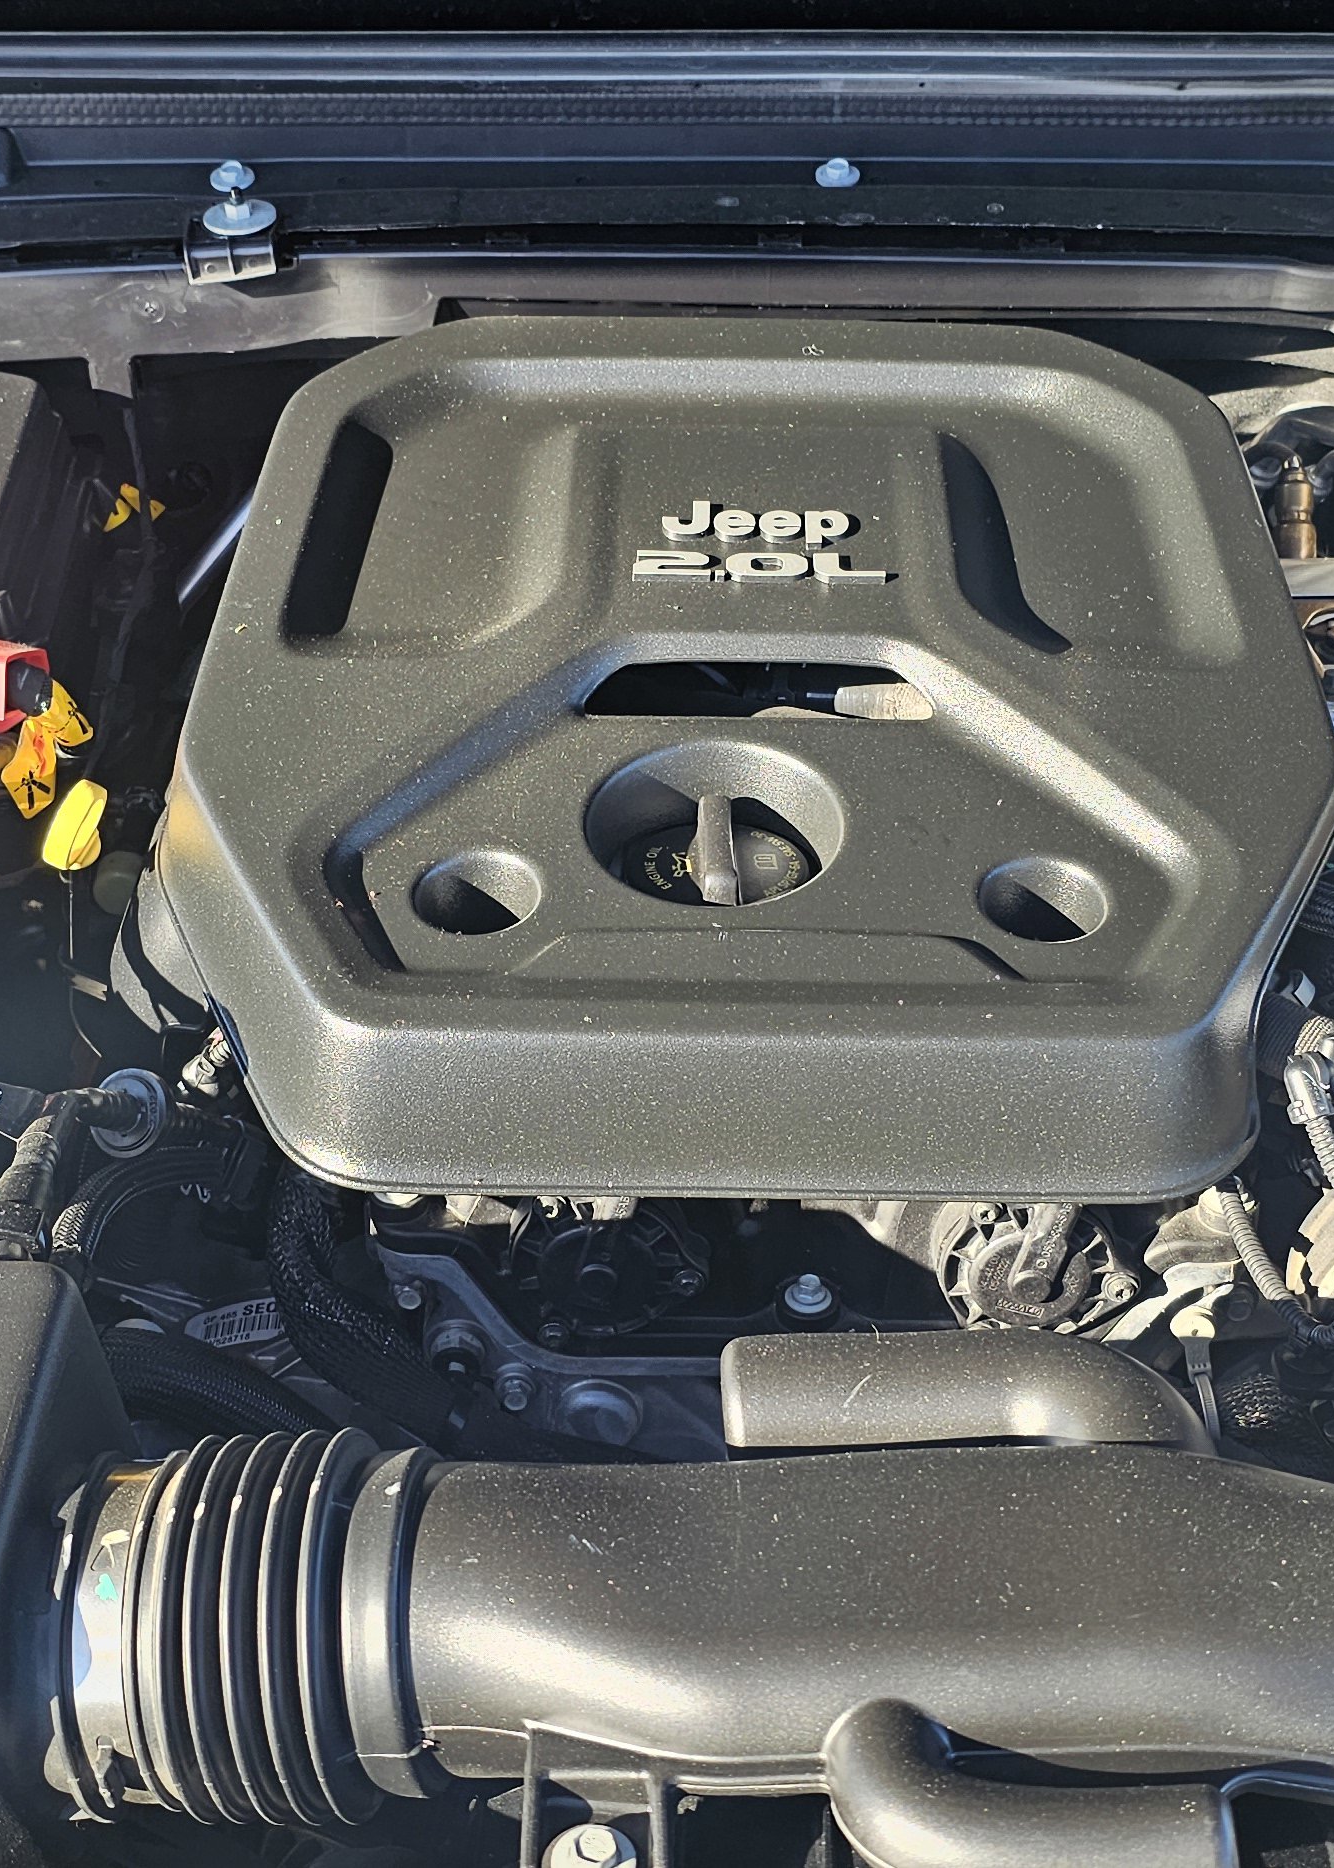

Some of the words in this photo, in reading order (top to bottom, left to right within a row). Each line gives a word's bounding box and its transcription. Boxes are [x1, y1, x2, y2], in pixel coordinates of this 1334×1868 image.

[661, 501, 850, 549] Jeep
[632, 550, 886, 584] 2.0L
[646, 846, 663, 859] OIL
[644, 860, 673, 890] ENGINE
